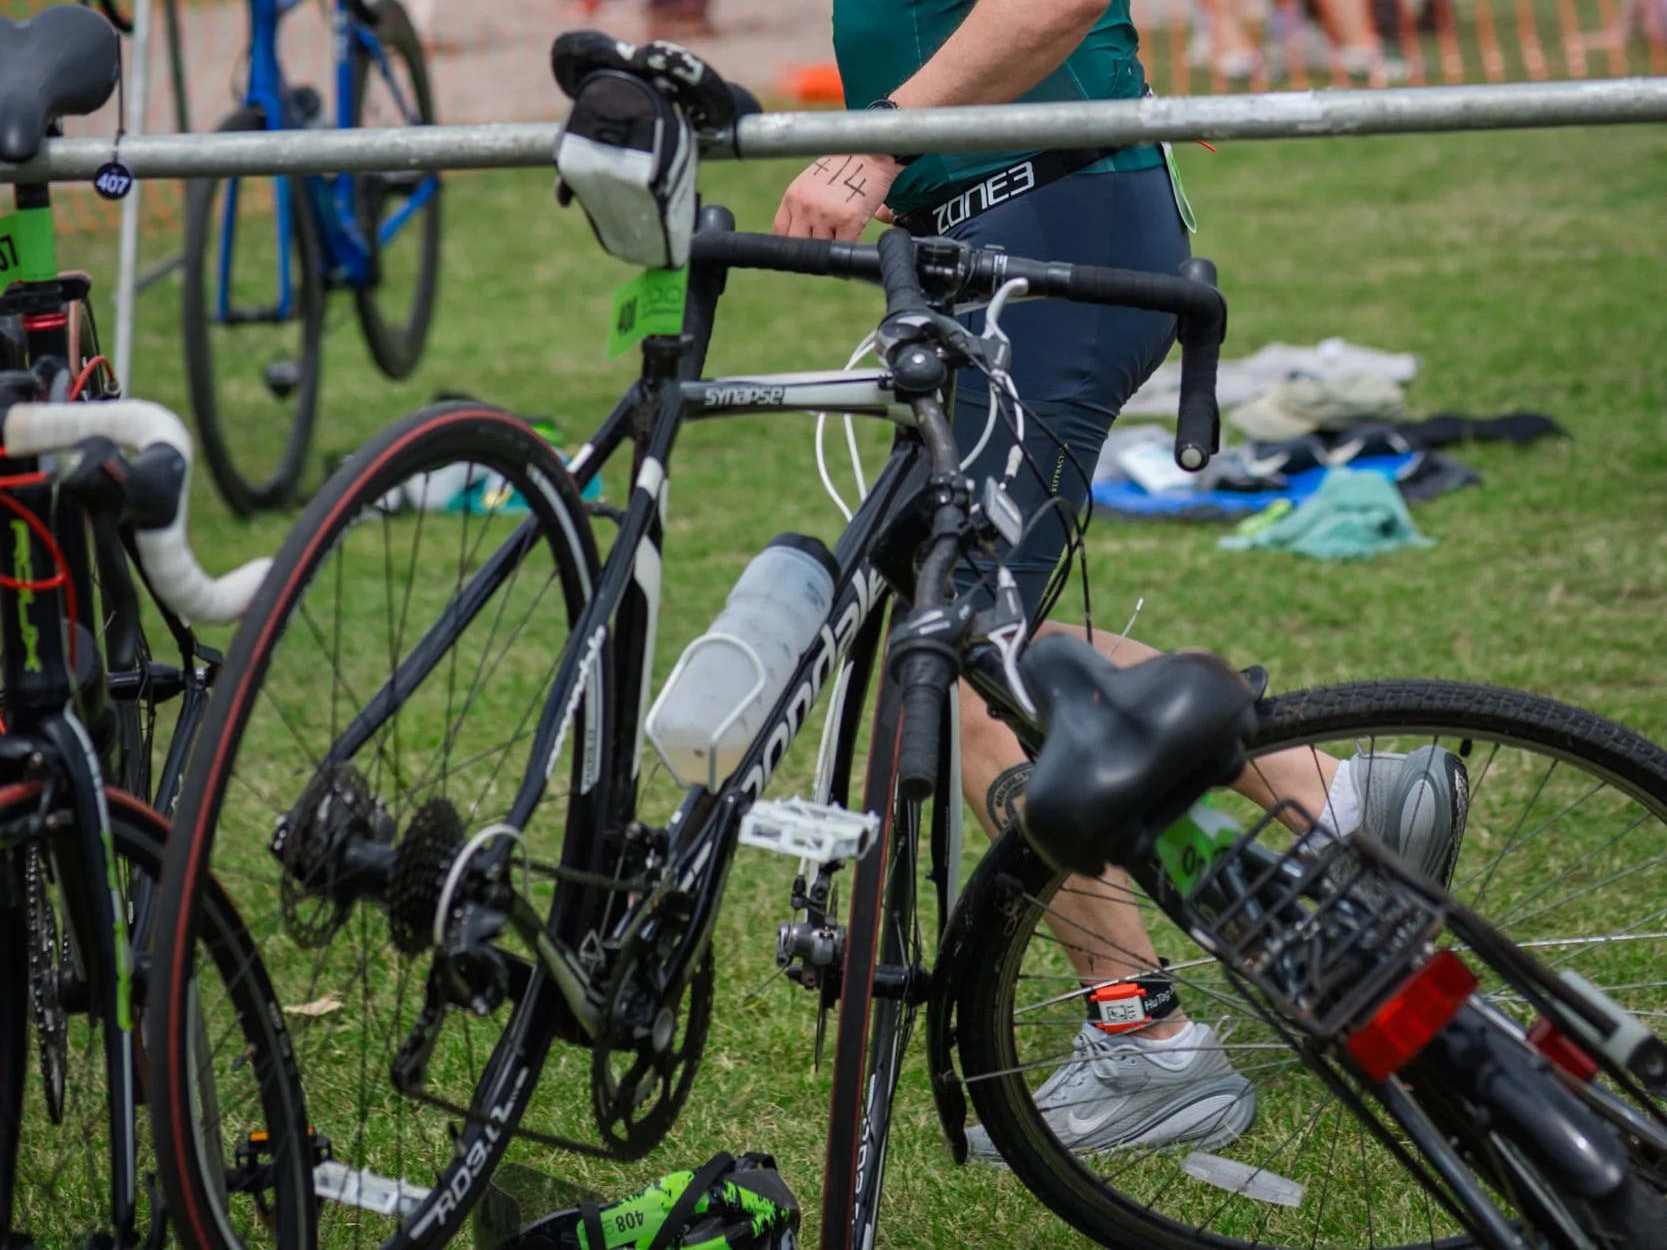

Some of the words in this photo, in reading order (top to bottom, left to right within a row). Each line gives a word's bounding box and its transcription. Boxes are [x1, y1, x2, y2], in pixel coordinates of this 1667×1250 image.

[96, 172, 130, 195] 407
[932, 161, 1035, 236] ZONE3
[615, 1208, 644, 1234] 408
